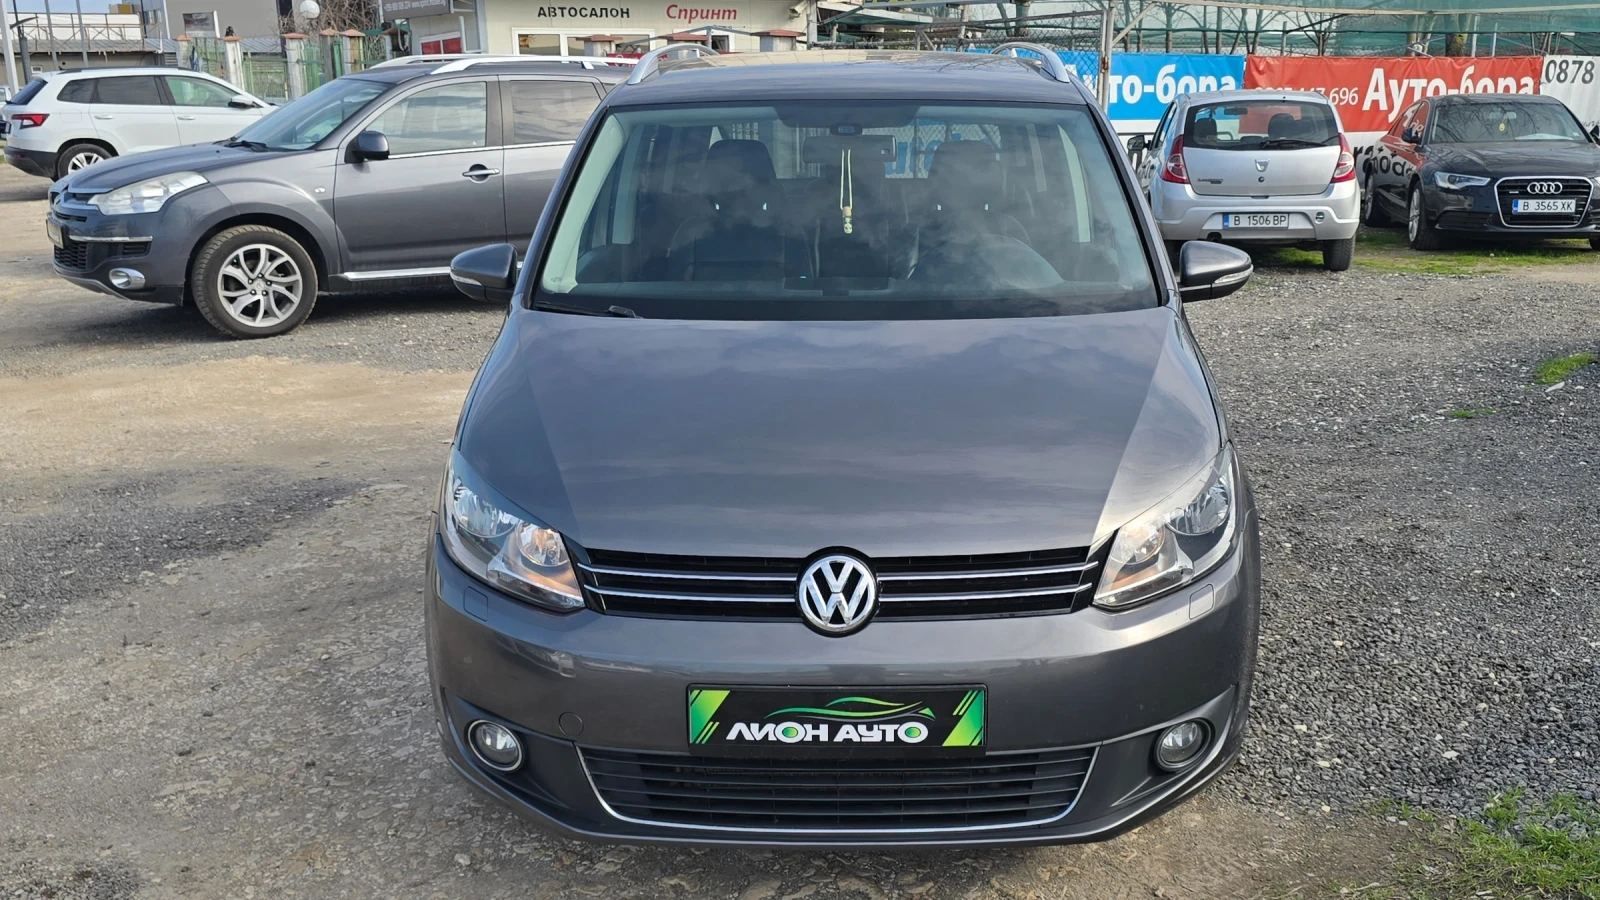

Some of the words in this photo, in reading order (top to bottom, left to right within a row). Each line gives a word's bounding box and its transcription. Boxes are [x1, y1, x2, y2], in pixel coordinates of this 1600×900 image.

[537, 6, 630, 19] АВТОСАЛОН
[666, 4, 738, 24] Спринт
[1545, 59, 1596, 85] 0878
[1329, 87, 1359, 106] 696
[1534, 201, 1559, 211] 3565
[1247, 215, 1271, 226] 1506
[725, 721, 830, 744] ЛИОН
[832, 720, 929, 744] АУТО
